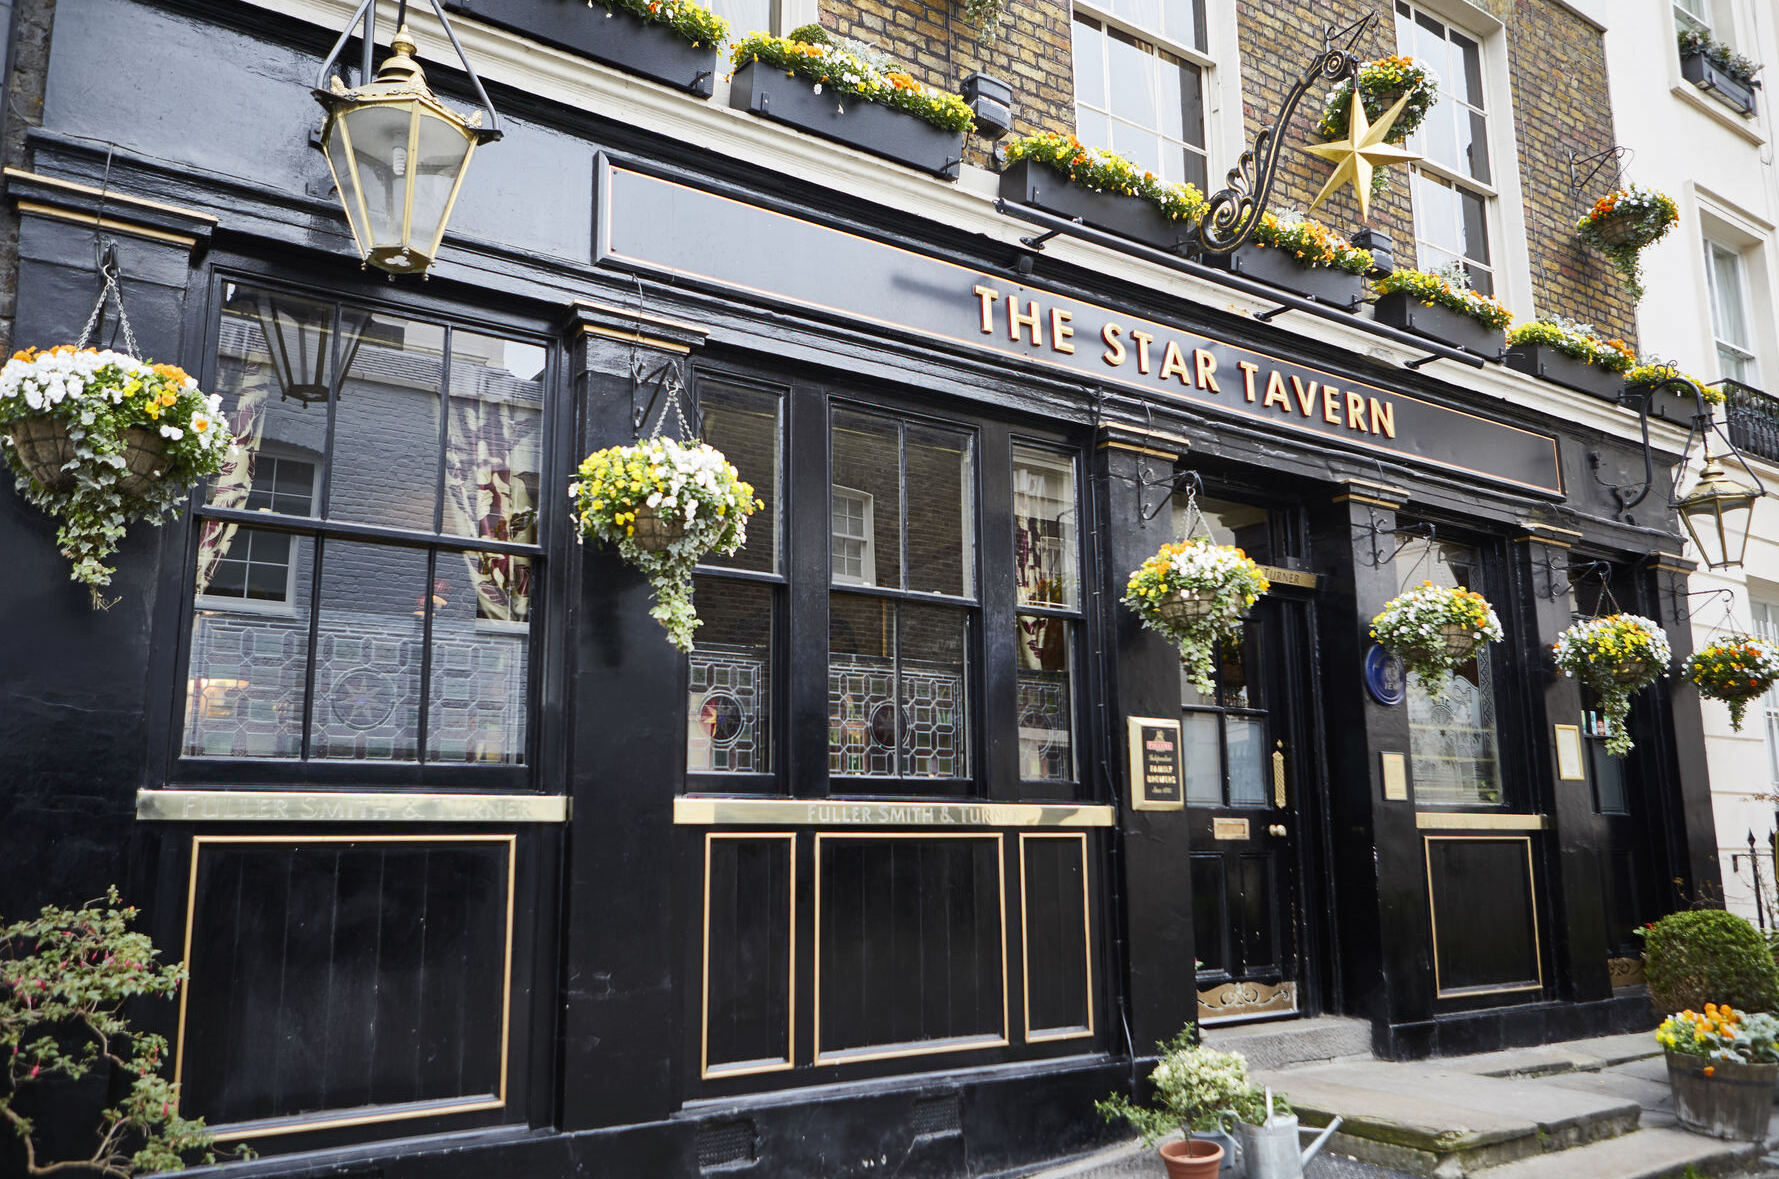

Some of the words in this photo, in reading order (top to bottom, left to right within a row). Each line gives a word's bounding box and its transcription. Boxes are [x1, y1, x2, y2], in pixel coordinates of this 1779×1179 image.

[973, 284, 1075, 354] THE
[1103, 321, 1220, 393] STAR
[1239, 360, 1396, 439] TAVERN
[1264, 567, 1300, 584] TURNER
[182, 795, 289, 818] FULLER
[301, 797, 391, 819] SMITH
[401, 797, 426, 819] &
[434, 798, 535, 820] TURNER
[806, 804, 872, 823] FULLER
[878, 805, 934, 824] SMITH
[940, 805, 957, 824] &
